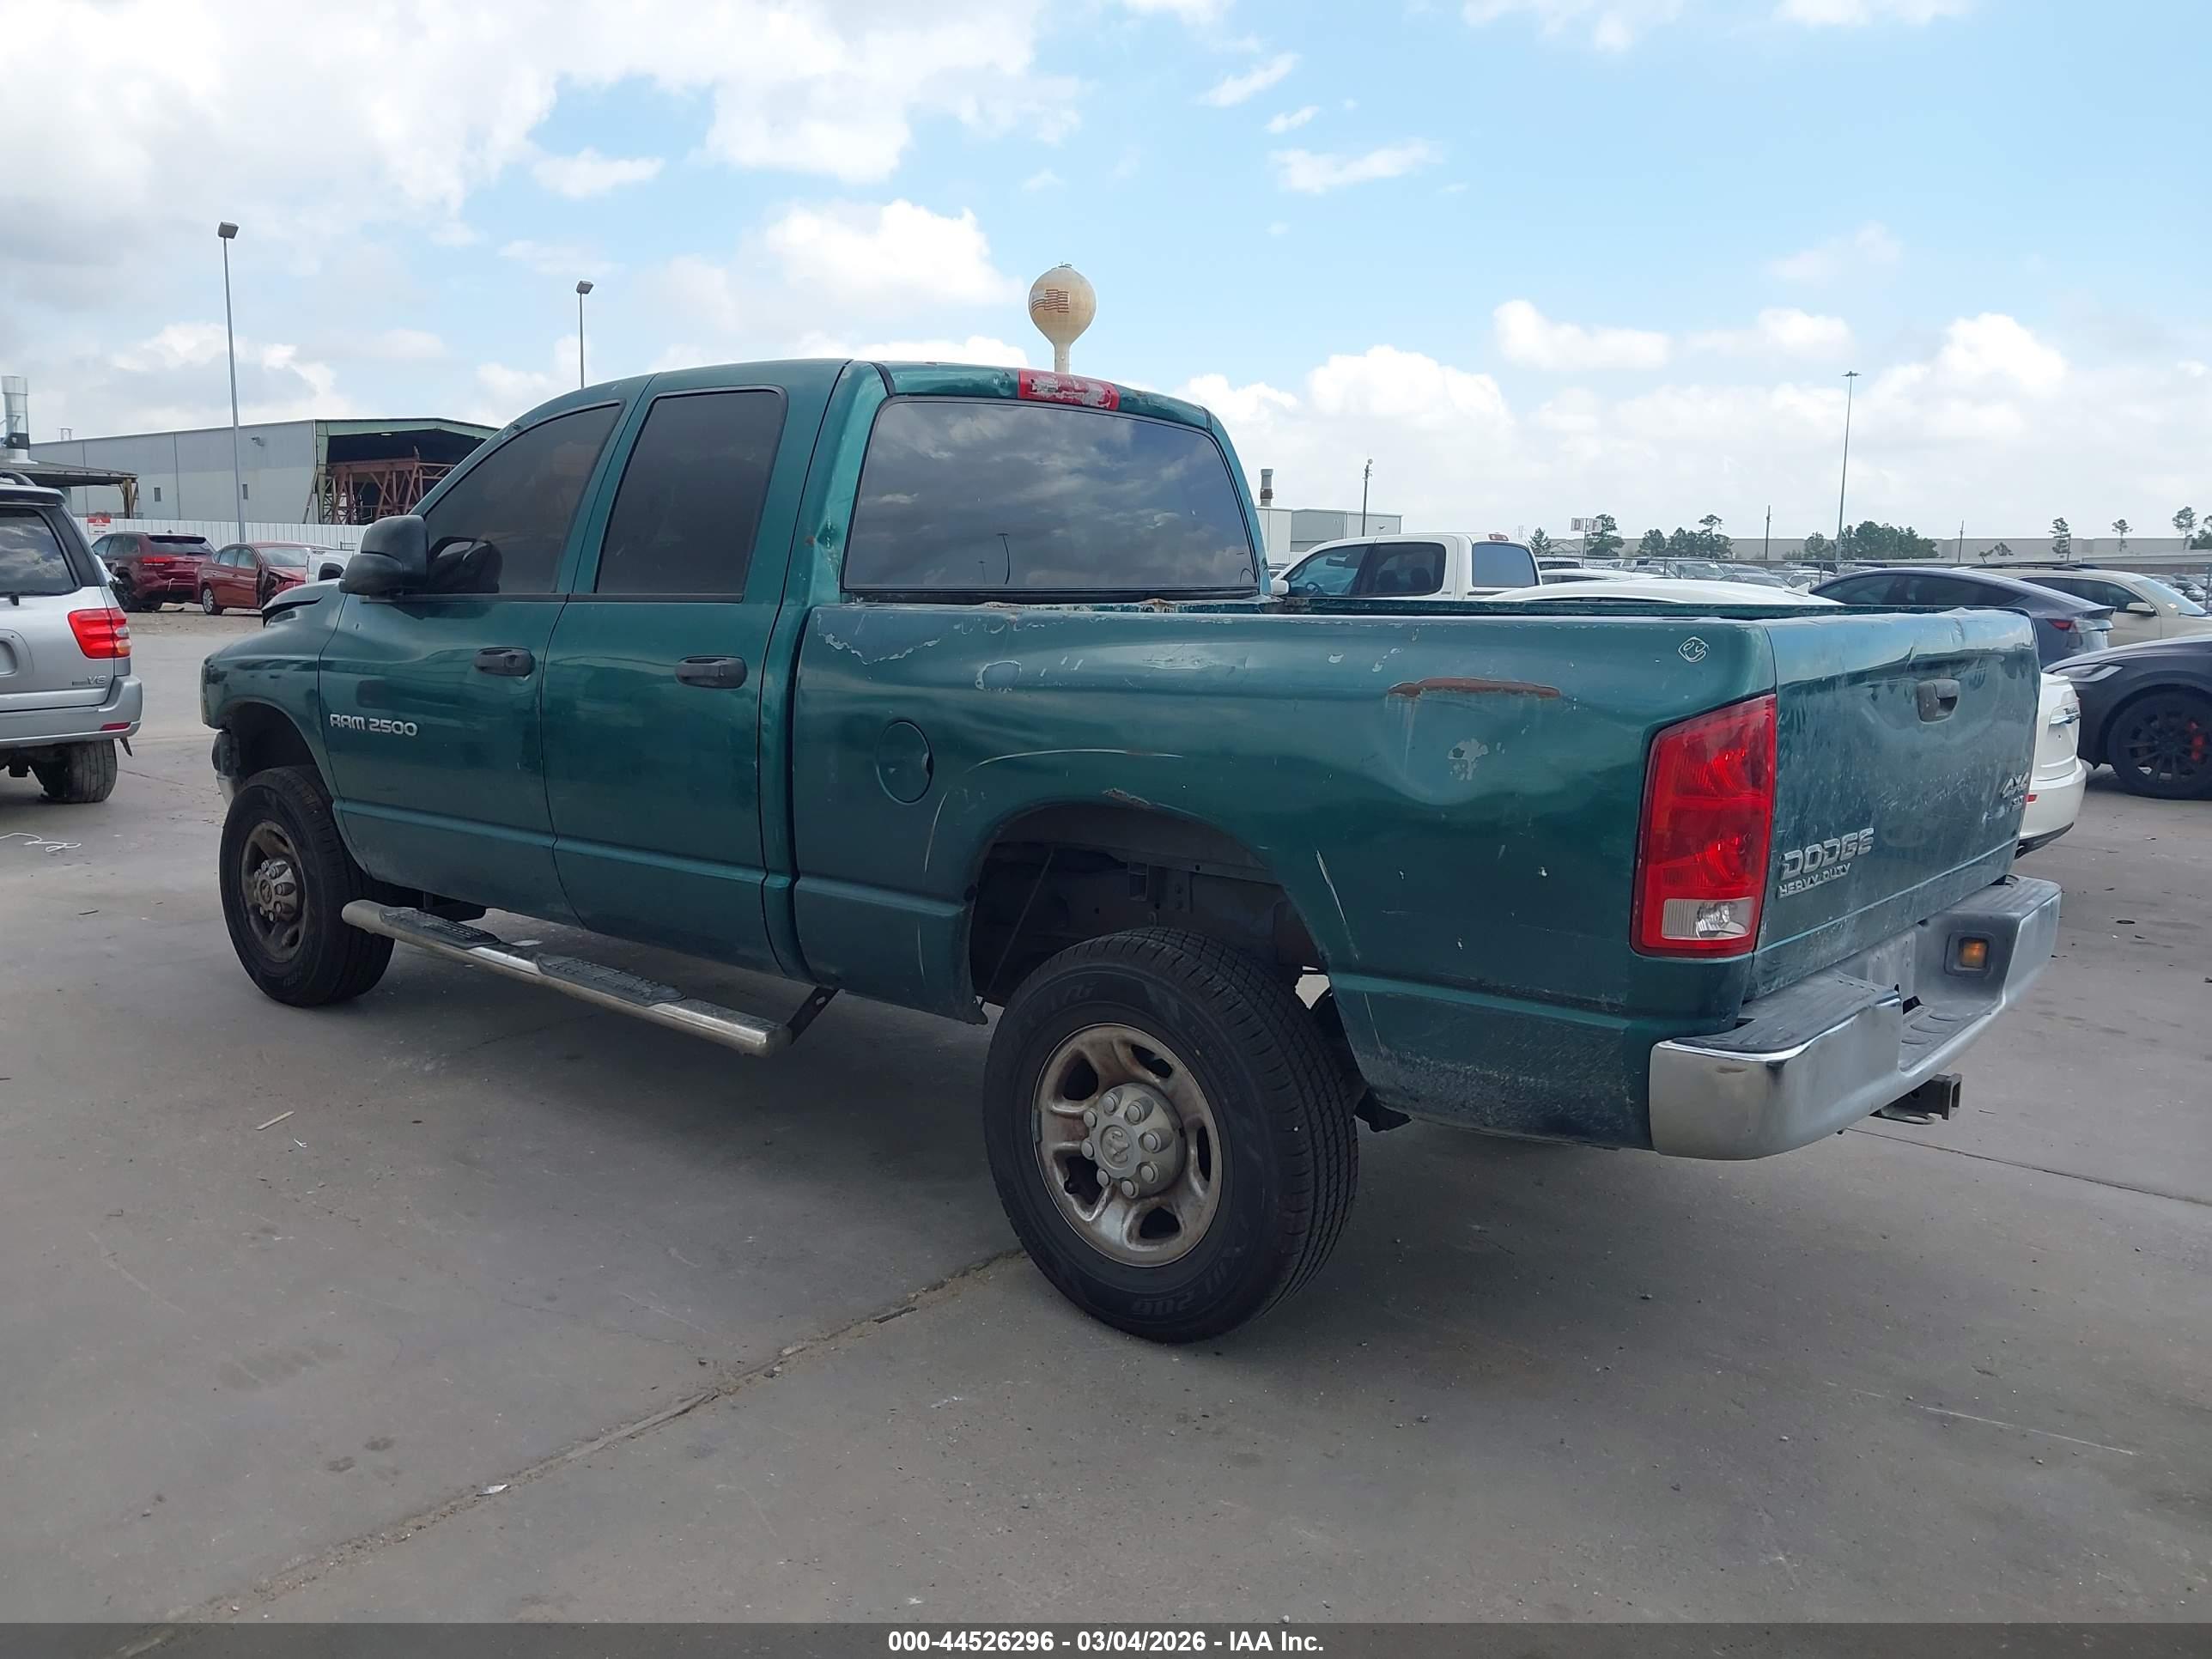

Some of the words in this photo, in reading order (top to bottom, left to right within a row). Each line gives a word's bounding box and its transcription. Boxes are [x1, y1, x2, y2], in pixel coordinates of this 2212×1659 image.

[330, 714, 366, 731] RAM
[368, 717, 418, 737] 2500
[1780, 827, 1875, 881] DODGE
[1777, 874, 1820, 898] HEAVY
[1822, 862, 1851, 883] DUTY
